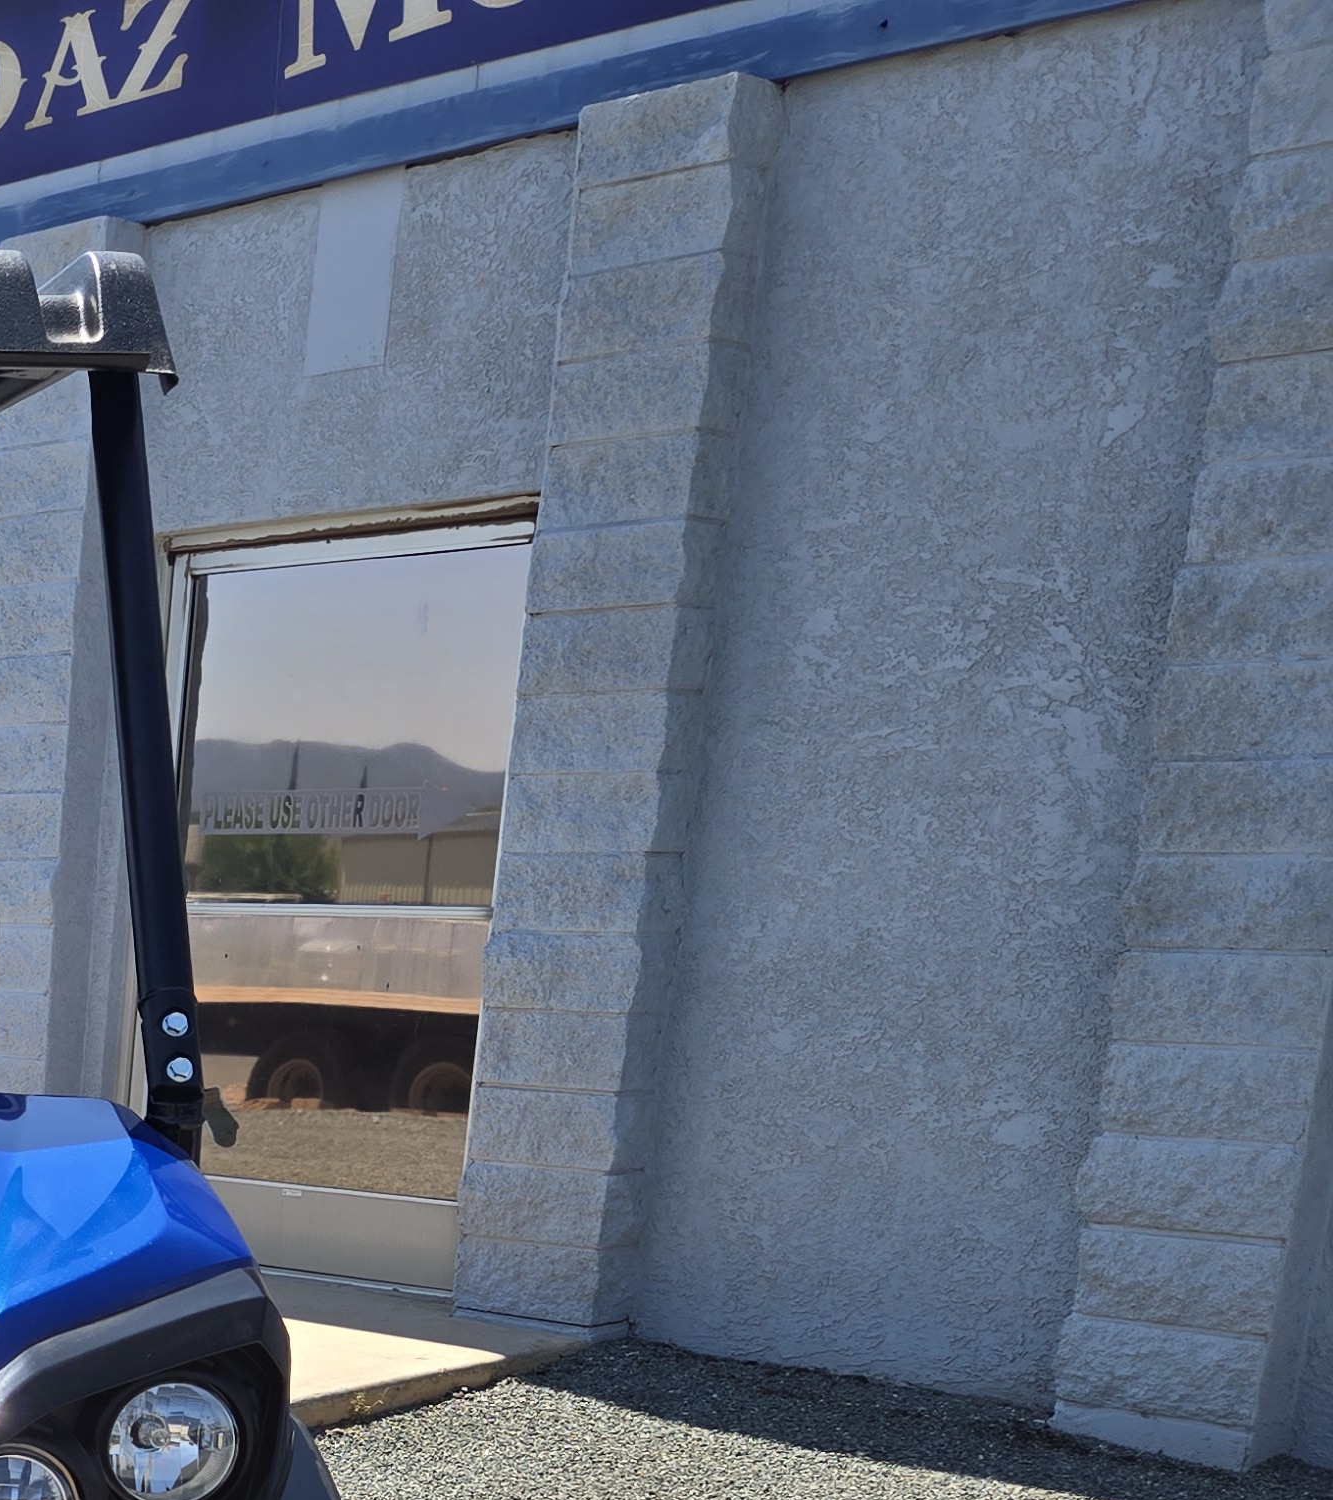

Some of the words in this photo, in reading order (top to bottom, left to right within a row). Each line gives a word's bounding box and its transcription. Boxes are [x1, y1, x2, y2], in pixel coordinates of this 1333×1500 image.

[203, 794, 265, 830] PLEASE
[268, 794, 302, 830] USE
[306, 793, 365, 830] OTHER
[368, 792, 421, 830] DOOR
